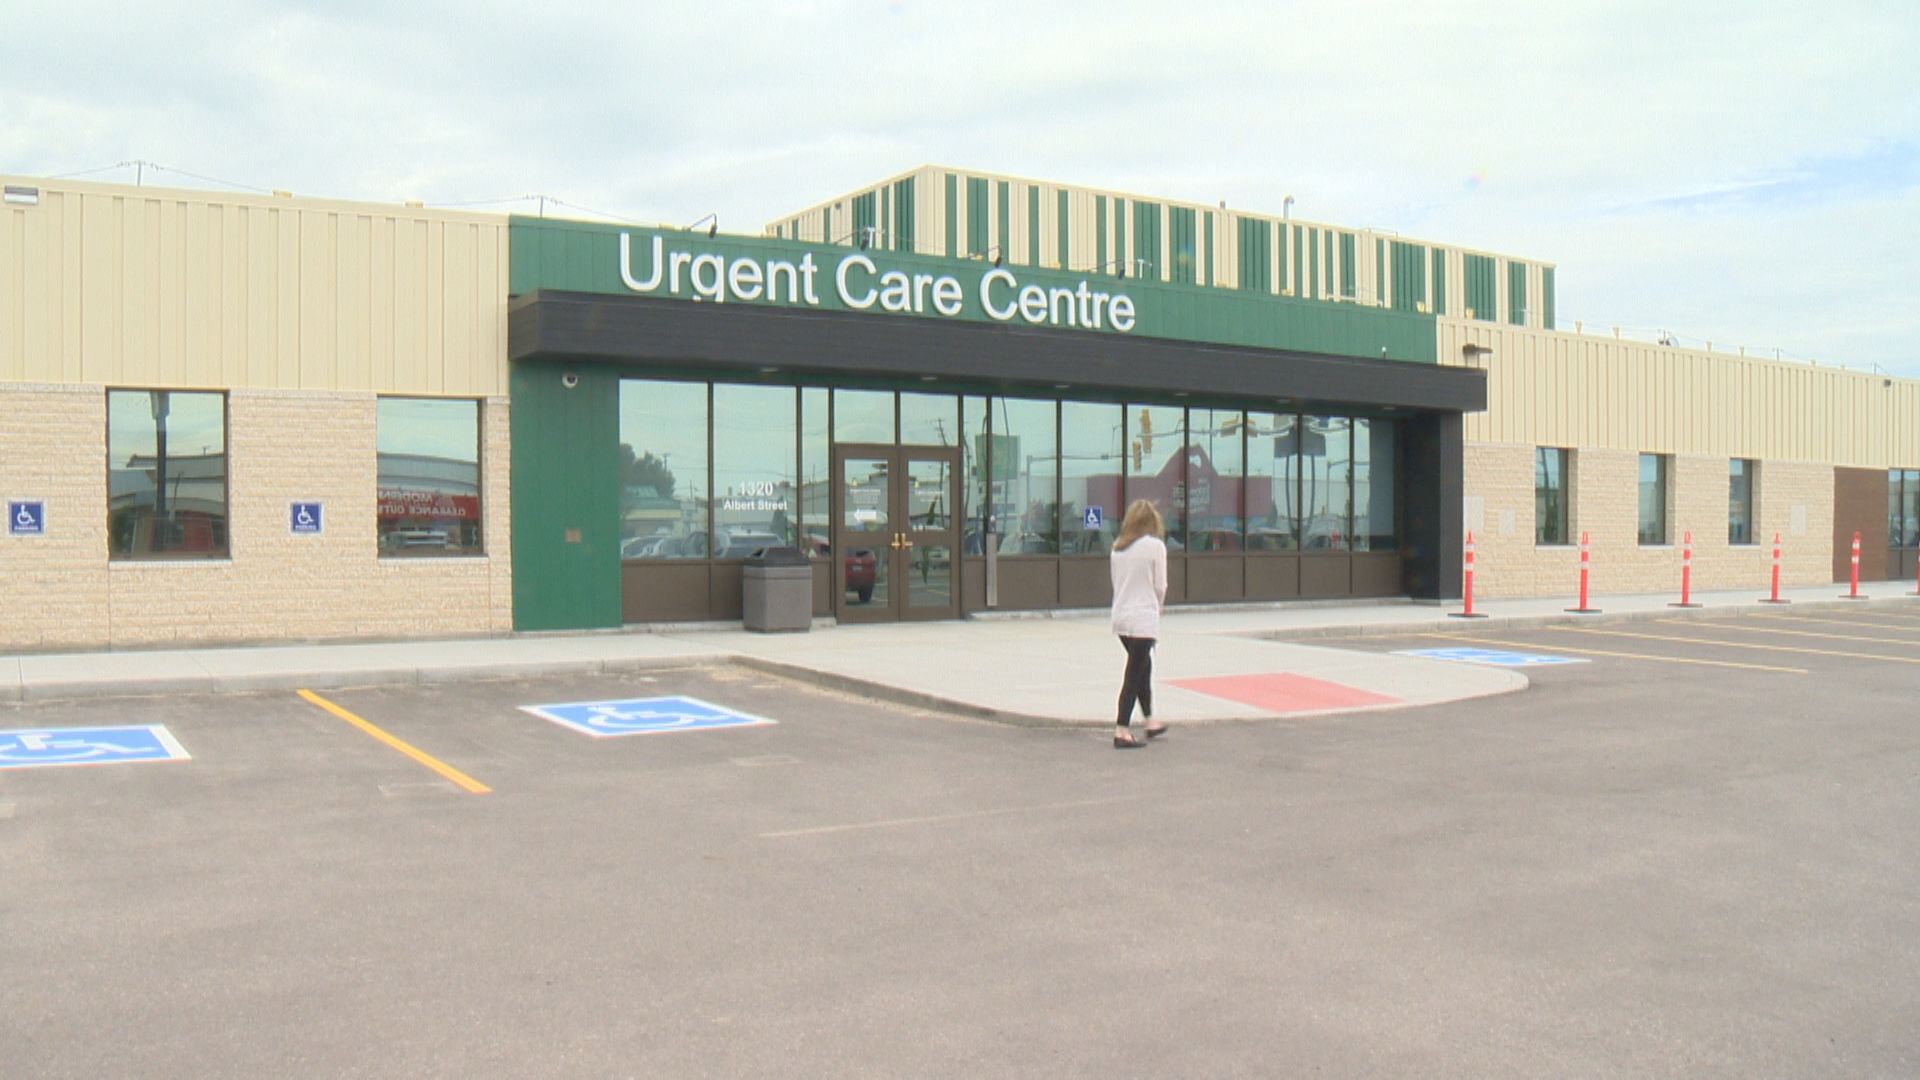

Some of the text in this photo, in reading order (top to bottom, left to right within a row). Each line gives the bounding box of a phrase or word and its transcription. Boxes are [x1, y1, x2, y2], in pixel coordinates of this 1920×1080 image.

[619, 232, 1137, 334] Urgent Care Centre
[740, 481, 773, 496] 1320
[723, 499, 788, 511] Albert Street
